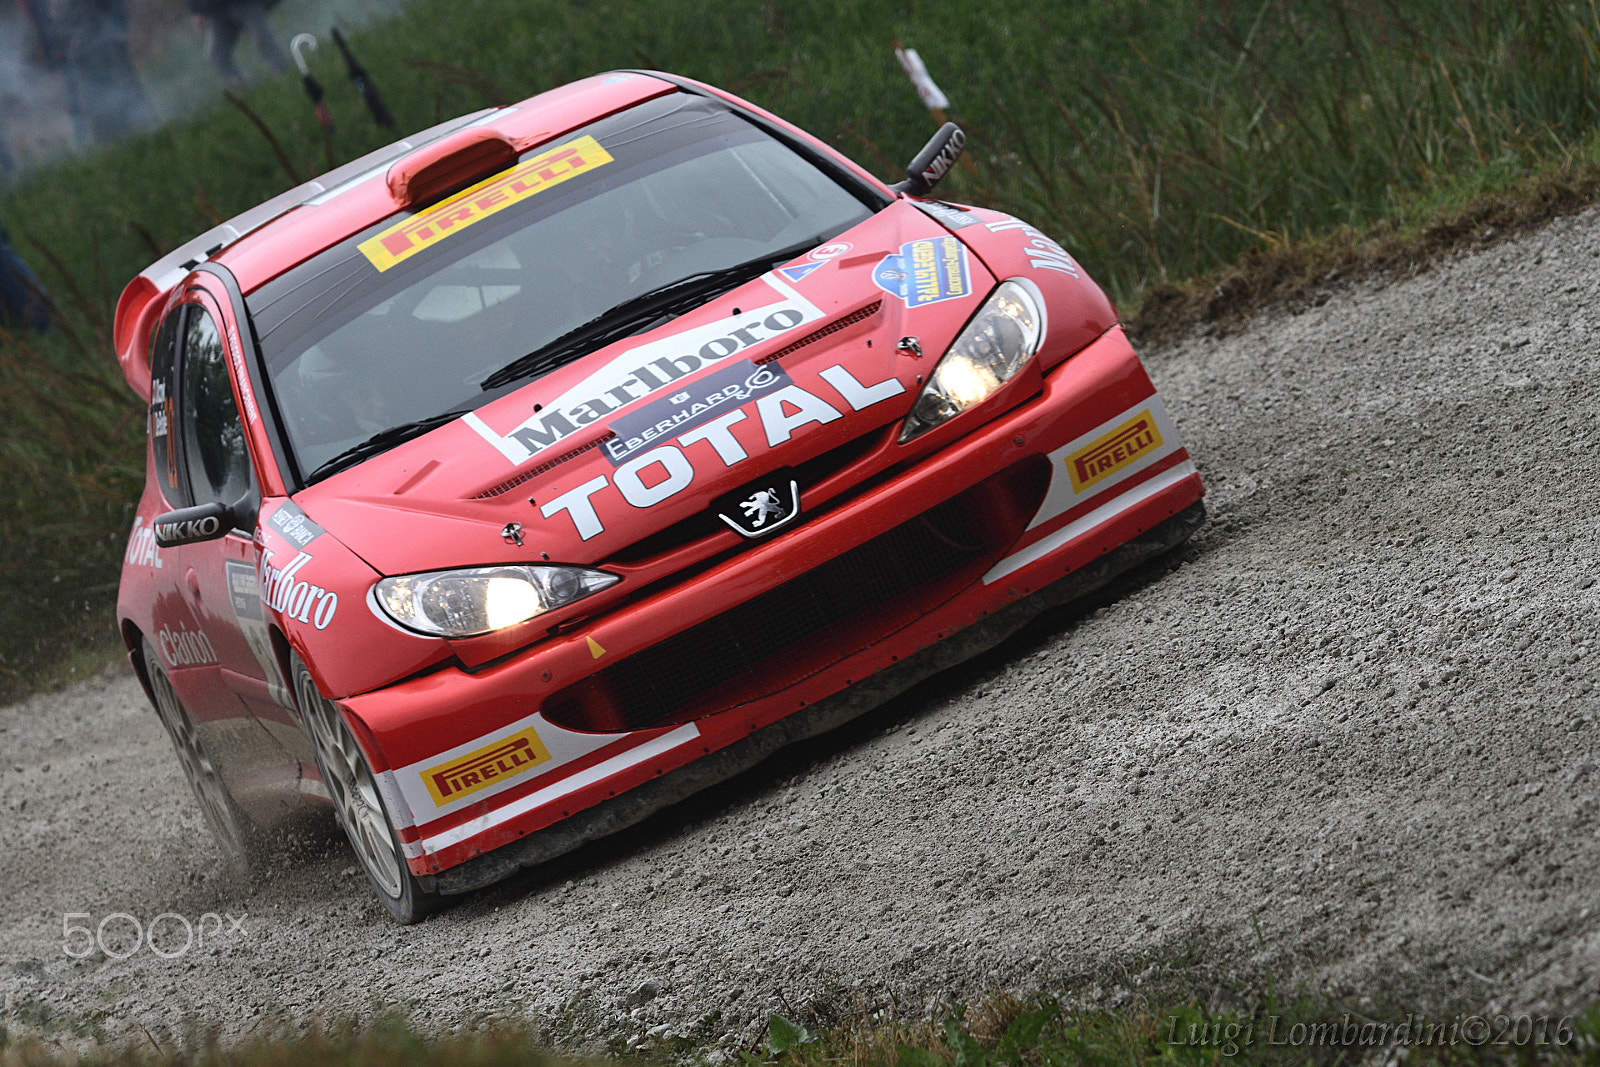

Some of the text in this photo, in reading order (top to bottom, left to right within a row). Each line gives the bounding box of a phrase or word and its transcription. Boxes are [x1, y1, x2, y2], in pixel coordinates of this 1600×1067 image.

[921, 129, 966, 187] NIKKO
[380, 148, 586, 257] PIRELLI
[508, 307, 804, 456] Marlboro
[539, 364, 907, 542] TOTAL
[605, 384, 741, 460] EBERHARD
[1074, 419, 1154, 484] PIRELLI
[125, 516, 163, 569] TOTAL
[155, 516, 219, 542] NIKKO
[432, 737, 537, 798] PIRELLI
